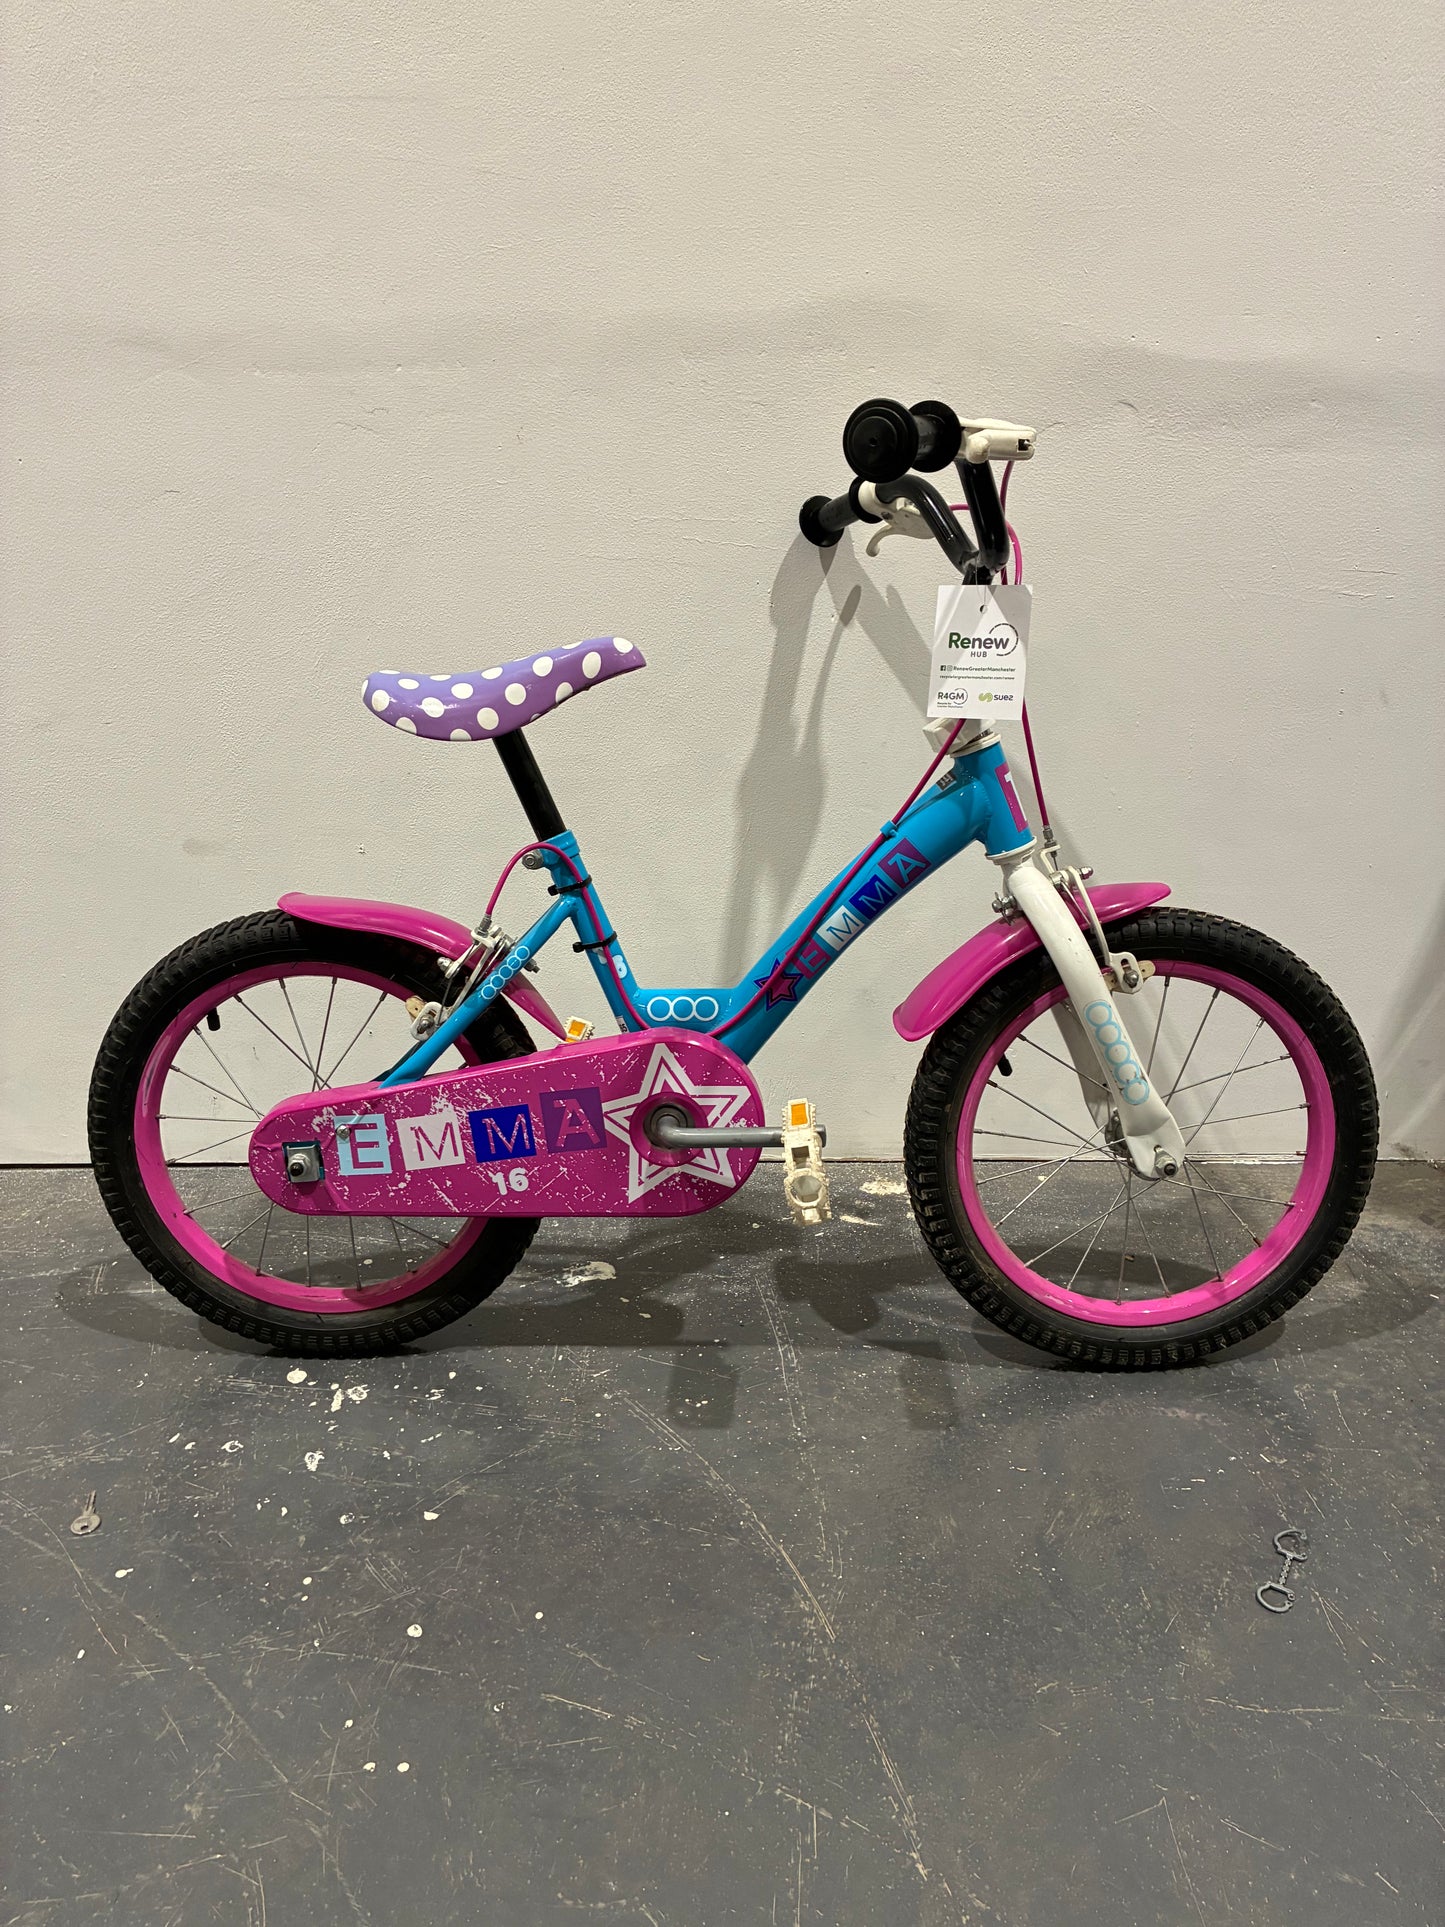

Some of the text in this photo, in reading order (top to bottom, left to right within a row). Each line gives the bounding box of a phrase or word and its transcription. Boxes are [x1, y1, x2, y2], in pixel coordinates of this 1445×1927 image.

[948, 632, 1009, 649] Renew
[937, 691, 964, 700] R4GM
[801, 852, 927, 971] EMMA
[347, 1097, 602, 1169] EMMA
[491, 1167, 530, 1196] 16
